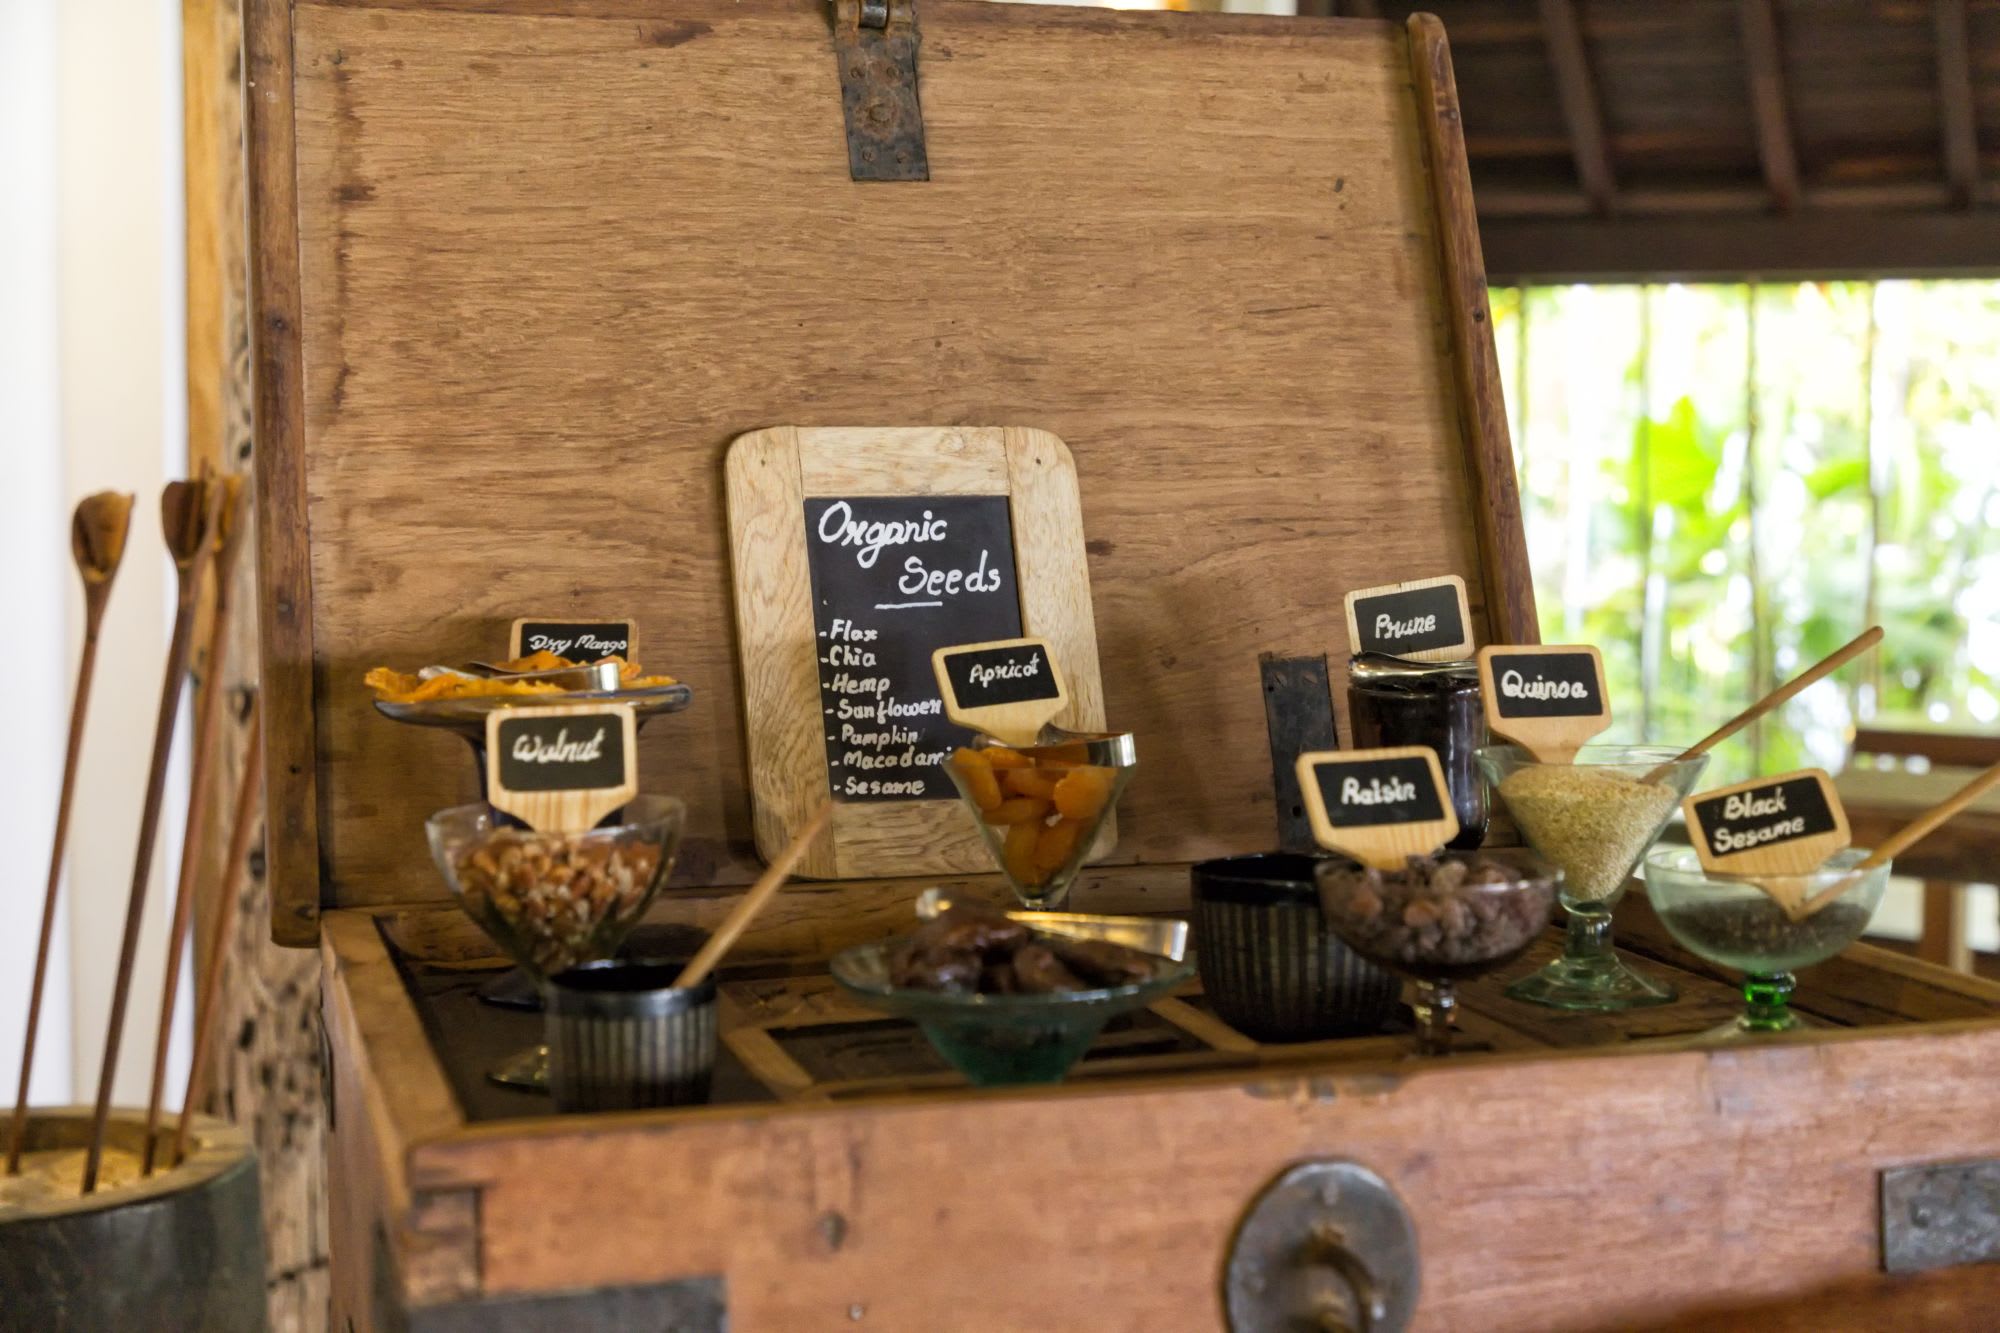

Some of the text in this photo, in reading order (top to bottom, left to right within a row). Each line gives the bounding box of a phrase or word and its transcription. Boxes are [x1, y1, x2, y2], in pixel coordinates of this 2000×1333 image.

[818, 500, 947, 568] Organic
[899, 549, 1000, 596] Seeds
[1375, 613, 1436, 639] Prune
[529, 634, 627, 655] Dry Mango
[969, 652, 1040, 688] Apricot
[1501, 670, 1588, 700] Quinoa
[512, 727, 605, 764] Walnut
[1341, 776, 1416, 805] Raisin
[1723, 786, 1786, 821] Black
[1713, 816, 1805, 853] Sesame
